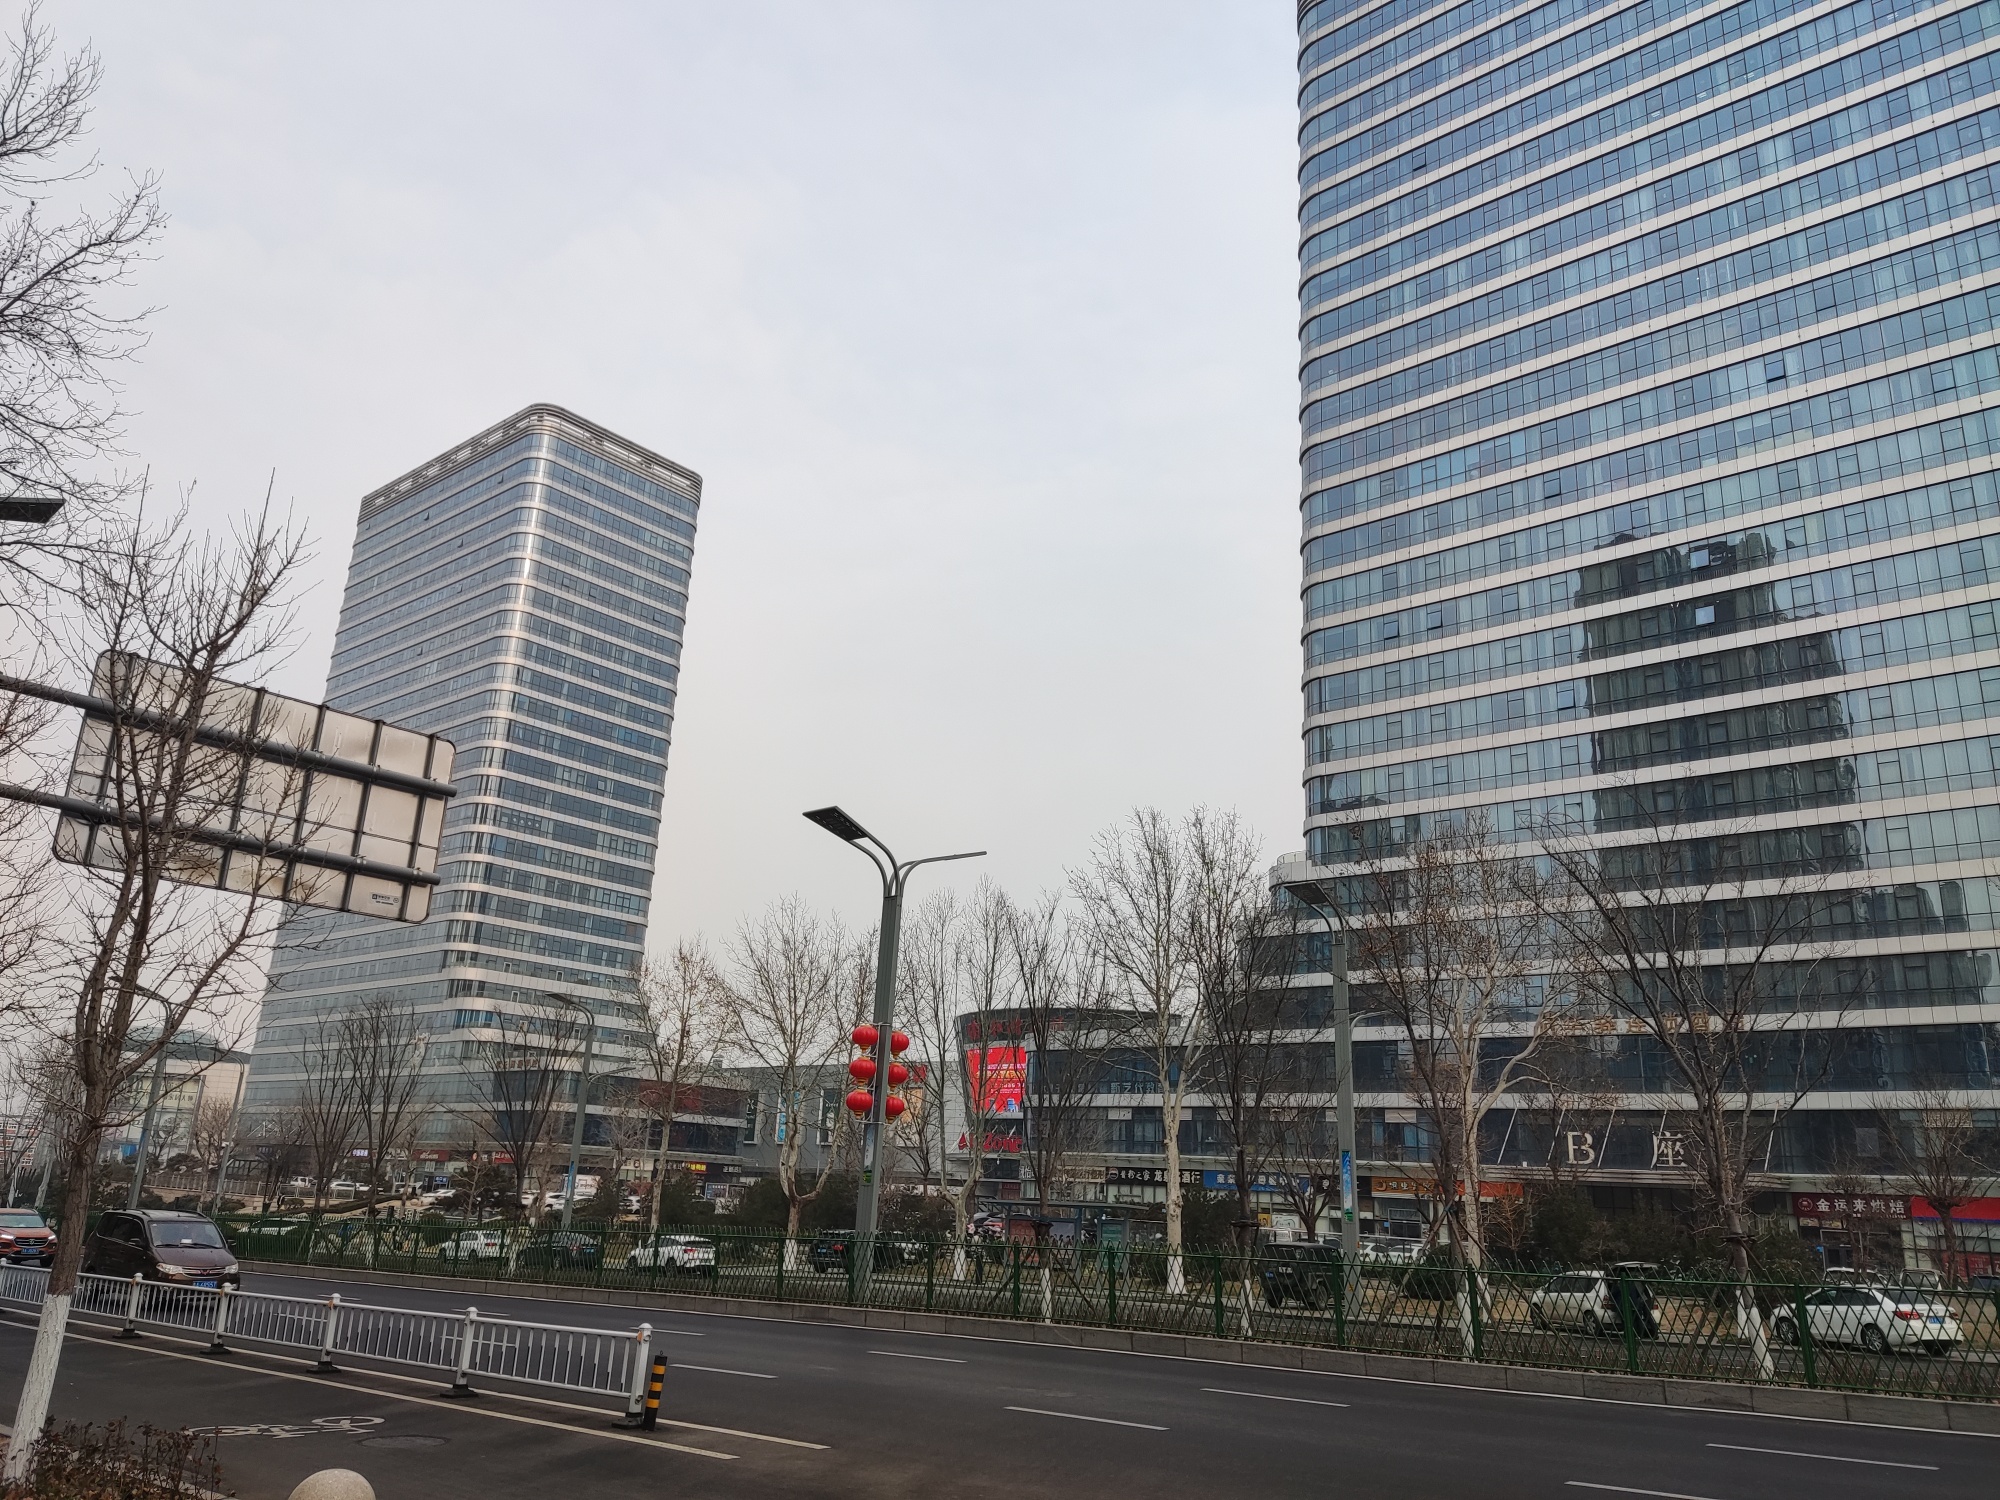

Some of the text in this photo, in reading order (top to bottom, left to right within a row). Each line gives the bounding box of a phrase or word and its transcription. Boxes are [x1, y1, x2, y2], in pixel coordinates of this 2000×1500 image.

[1565, 1131, 1689, 1168] B 座
[1154, 1169, 1201, 1184] 龙泉酒行
[1815, 1198, 1905, 1214] 金运来烘焙
